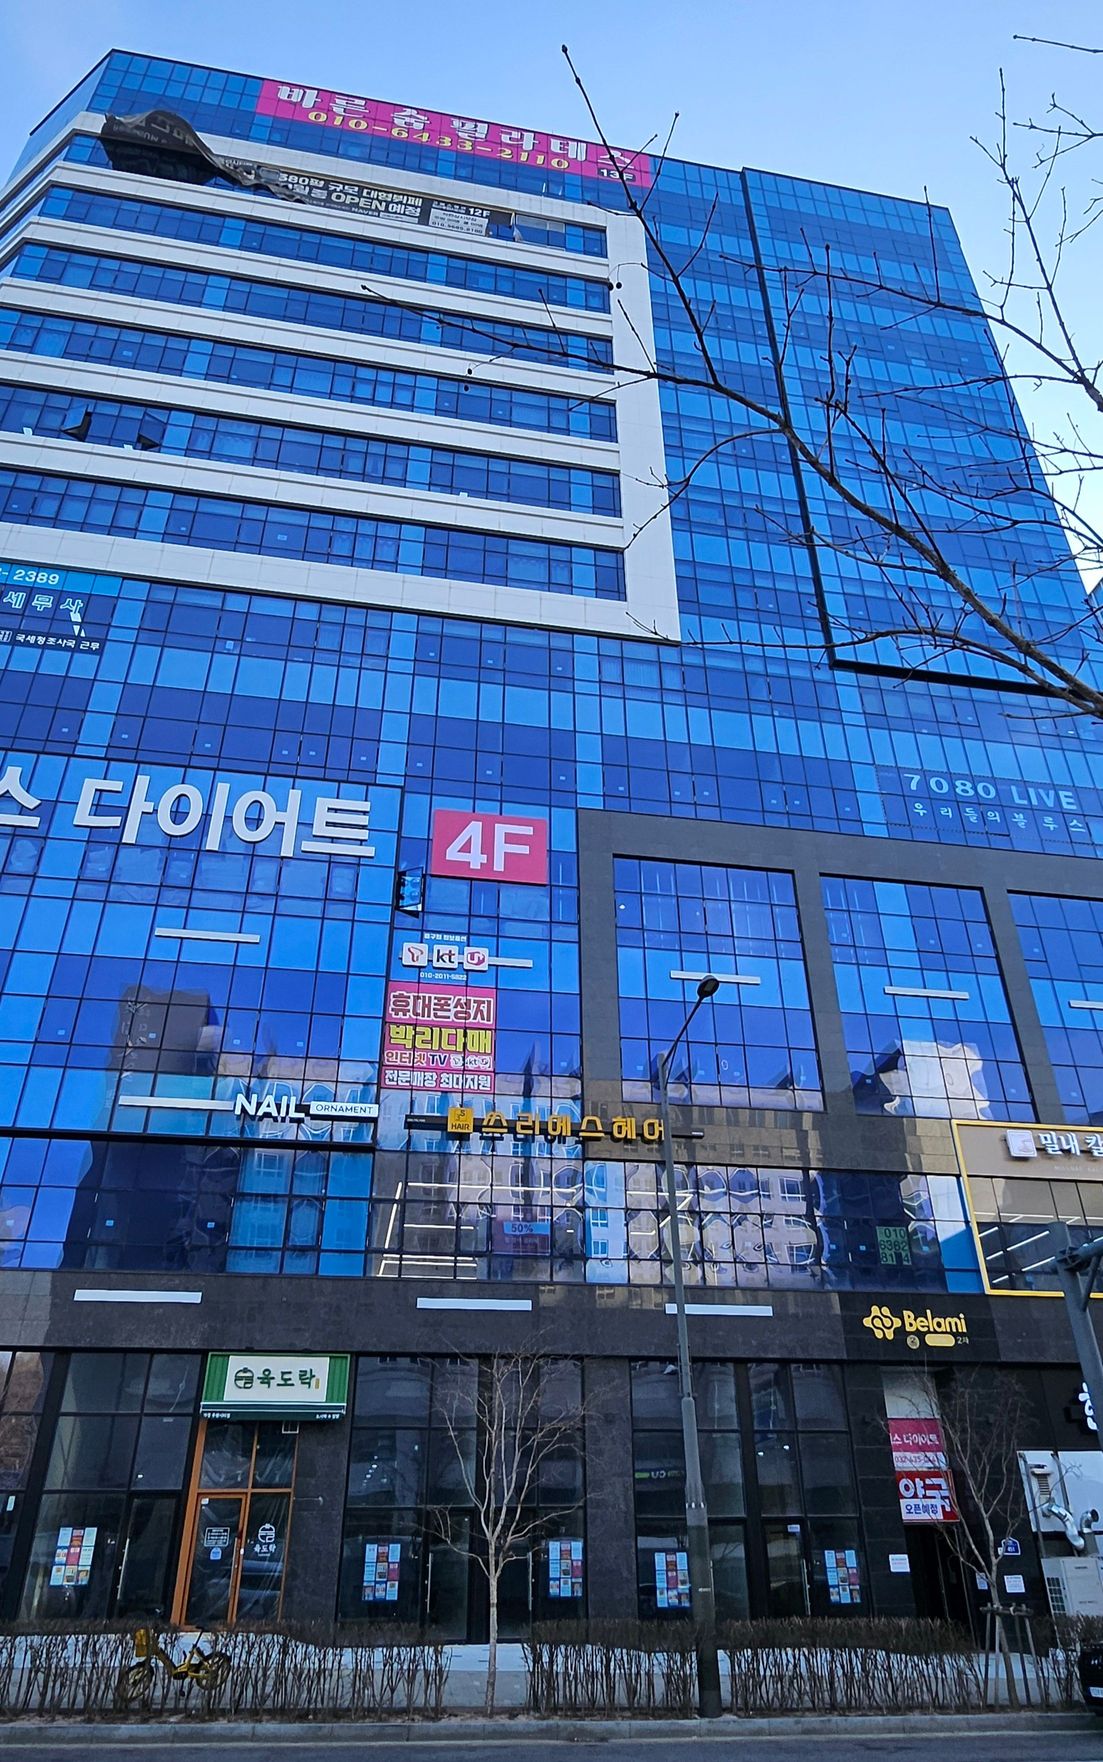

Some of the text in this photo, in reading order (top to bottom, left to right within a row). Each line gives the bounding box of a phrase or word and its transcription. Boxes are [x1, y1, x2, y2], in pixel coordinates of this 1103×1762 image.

[308, 111, 569, 169] 010-6433-2110
[331, 192, 386, 211] OPEN
[388, 203, 421, 217] 예정
[351, 206, 379, 217] NAVER
[468, 207, 491, 218] 12F
[0, 567, 60, 585] -2389
[16, 633, 76, 648] 국세청조사국
[79, 640, 100, 651] 근무
[903, 773, 1078, 810] 7080 LIVE
[73, 774, 376, 858] 다이어트
[445, 820, 534, 872] 4F
[436, 948, 456, 964] kt
[390, 991, 493, 1023] 휴대폰성지
[389, 1024, 492, 1054] 박리다매
[385, 1050, 426, 1065] 인터넷
[428, 1053, 448, 1066] TV
[384, 1069, 492, 1091] 전문매장 최대지원
[234, 1093, 375, 1119] NAIL ORNAMENT
[451, 1122, 470, 1131] HAIR
[511, 1223, 534, 1233] 50%
[884, 1227, 906, 1240] 010
[902, 1309, 967, 1333] Belami
[257, 1368, 316, 1389] 육도락
[905, 1503, 938, 1515] 오픈예정
